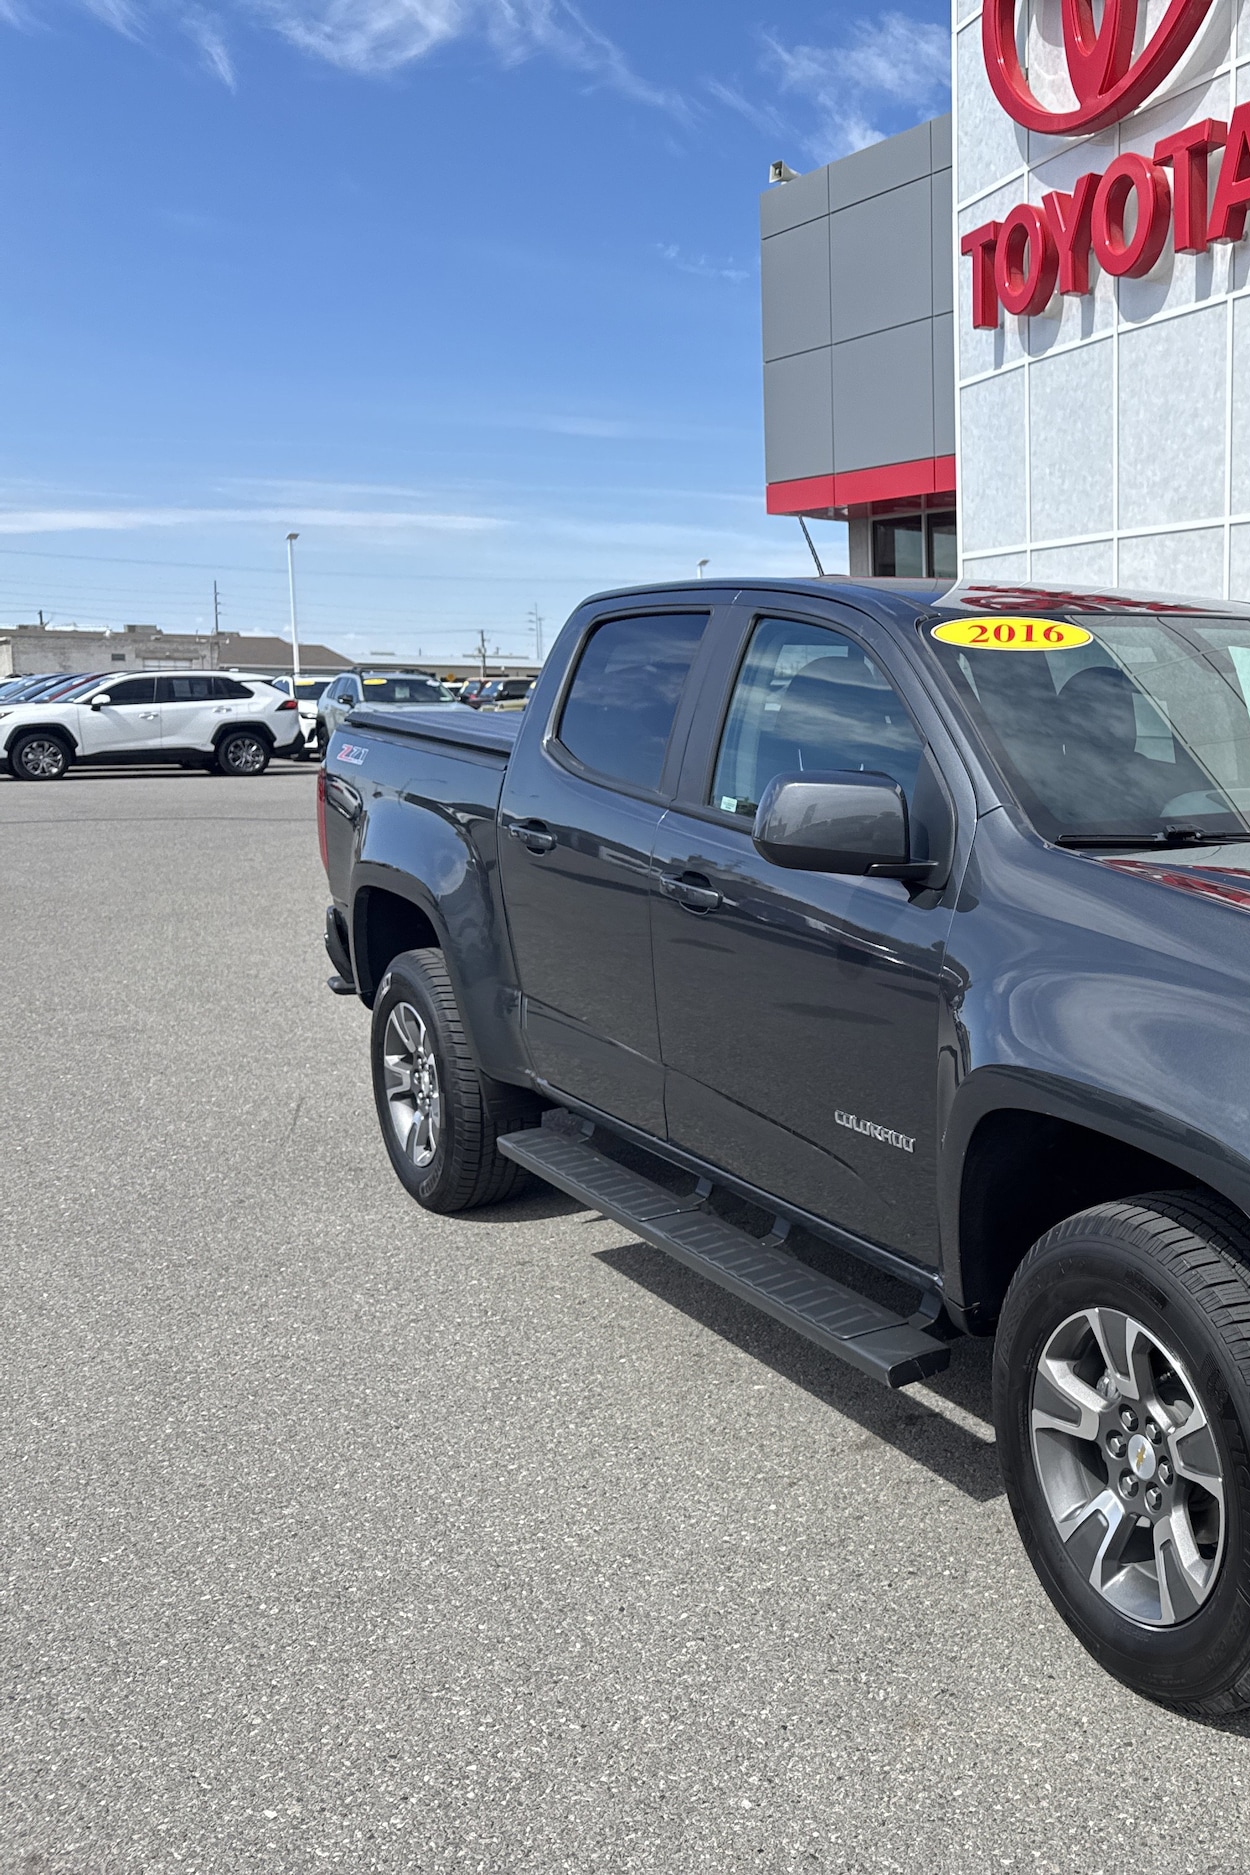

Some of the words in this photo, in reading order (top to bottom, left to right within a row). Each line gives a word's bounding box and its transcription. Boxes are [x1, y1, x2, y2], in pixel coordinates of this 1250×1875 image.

[967, 624, 1065, 643] 2016
[337, 744, 369, 765] Z71
[834, 1110, 916, 1153] COLORADO
